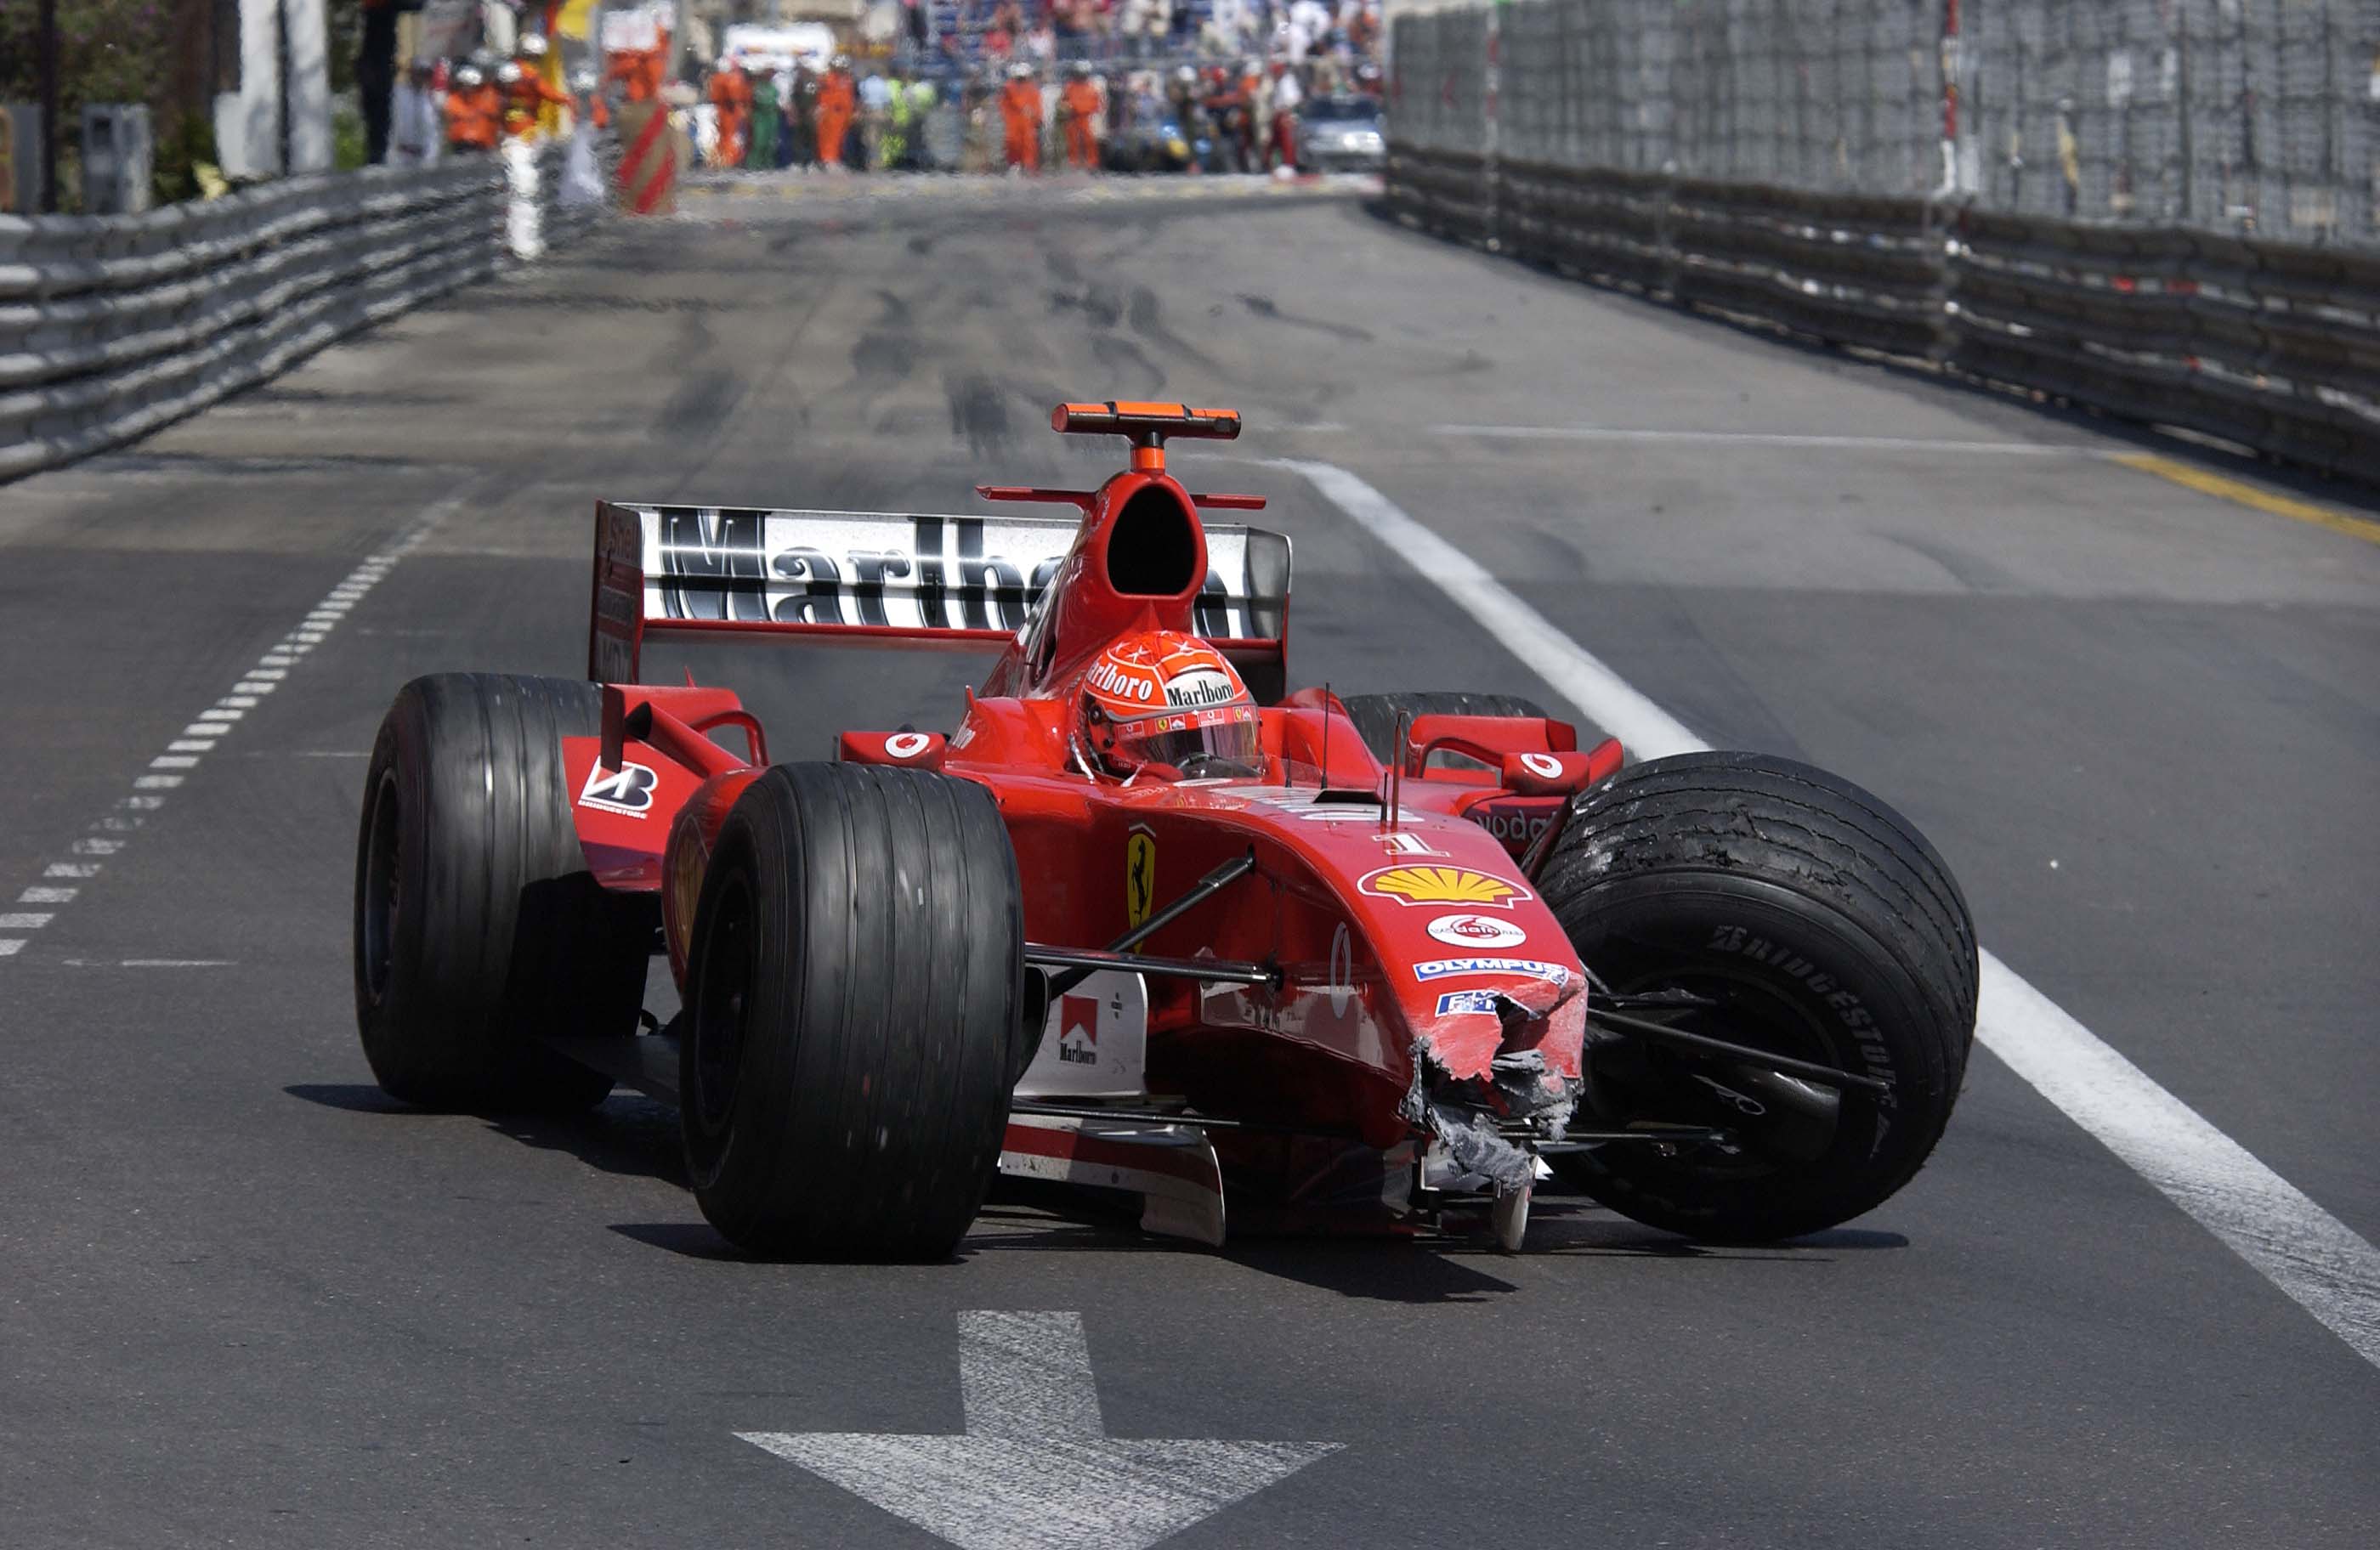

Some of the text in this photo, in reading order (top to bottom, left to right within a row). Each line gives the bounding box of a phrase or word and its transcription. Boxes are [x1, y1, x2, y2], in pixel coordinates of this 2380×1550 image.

[657, 510, 1231, 639] Marlb
[1087, 661, 1153, 701] arlboro
[1166, 679, 1235, 707] Marlboro
[1475, 809, 1558, 842] voda
[1371, 832, 1451, 857] 1
[1059, 1039, 1097, 1066] Marlboro
